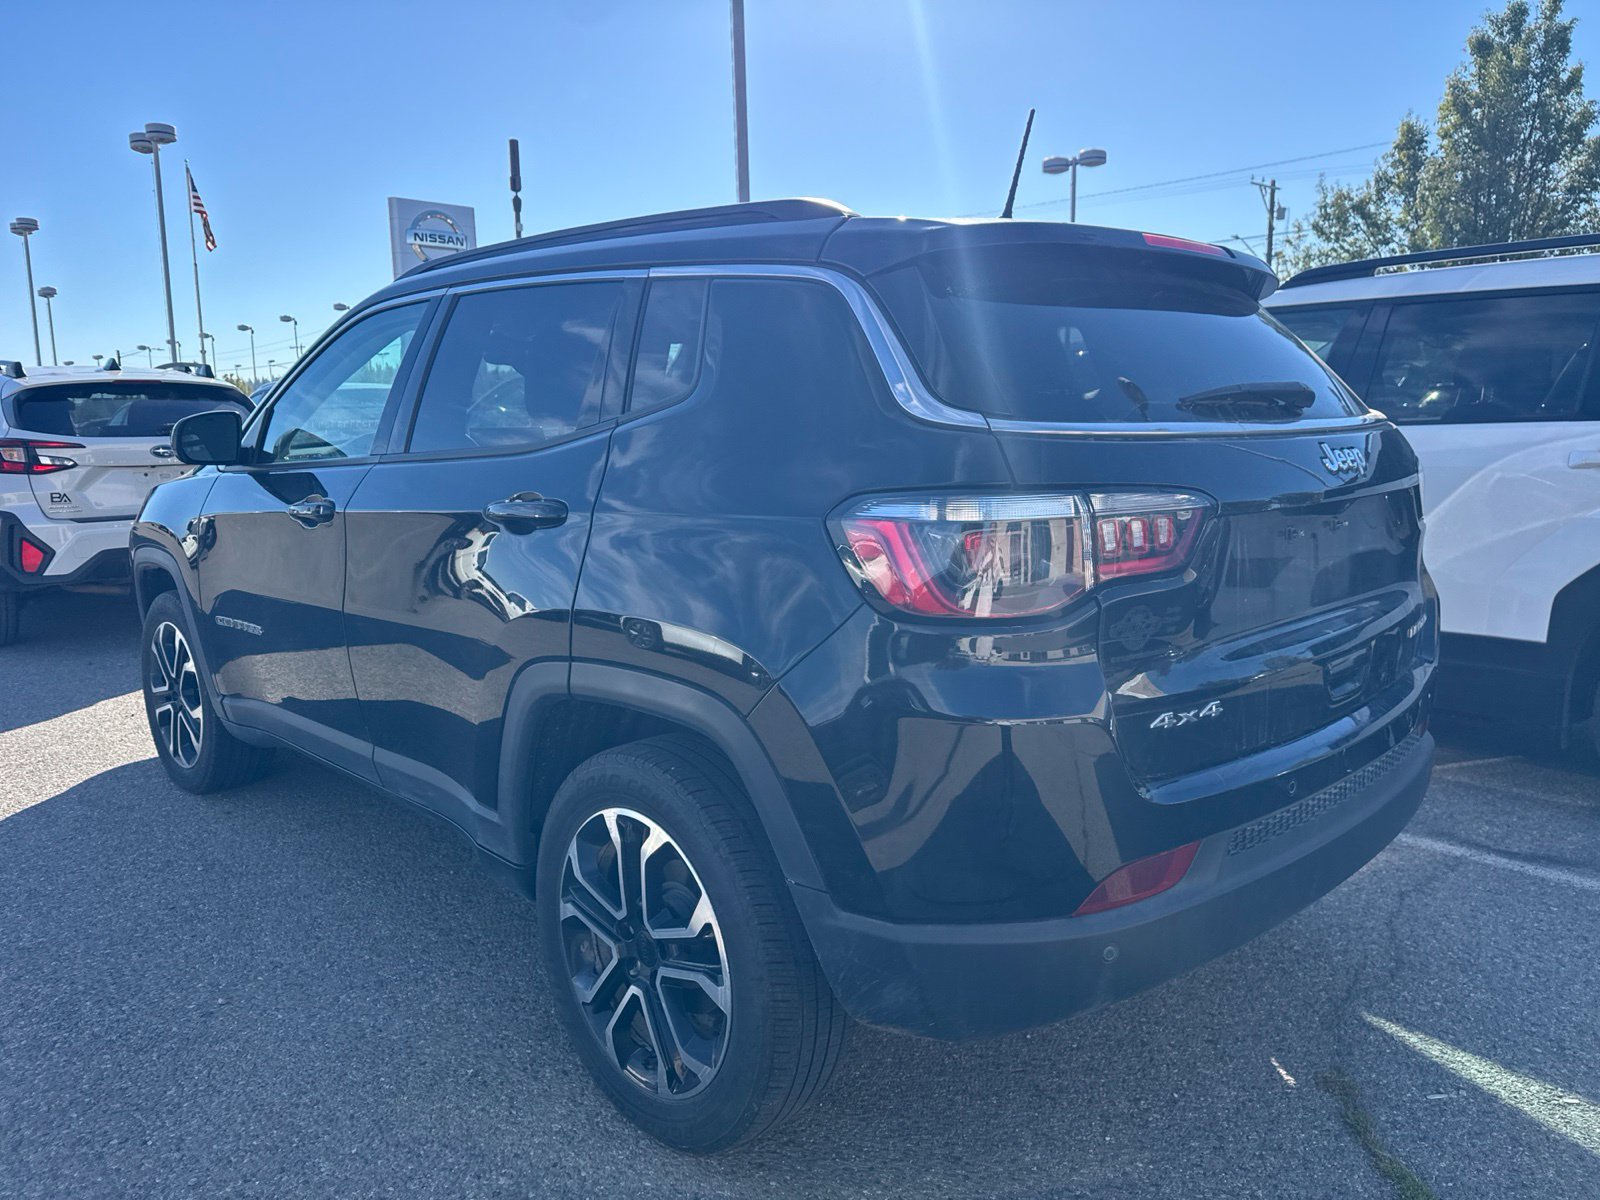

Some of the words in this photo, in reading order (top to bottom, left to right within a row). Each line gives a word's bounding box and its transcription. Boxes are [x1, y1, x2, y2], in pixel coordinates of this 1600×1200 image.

[413, 232, 464, 246] NISSAN
[1319, 442, 1366, 477] Jeep
[1149, 700, 1224, 728] 4x4
